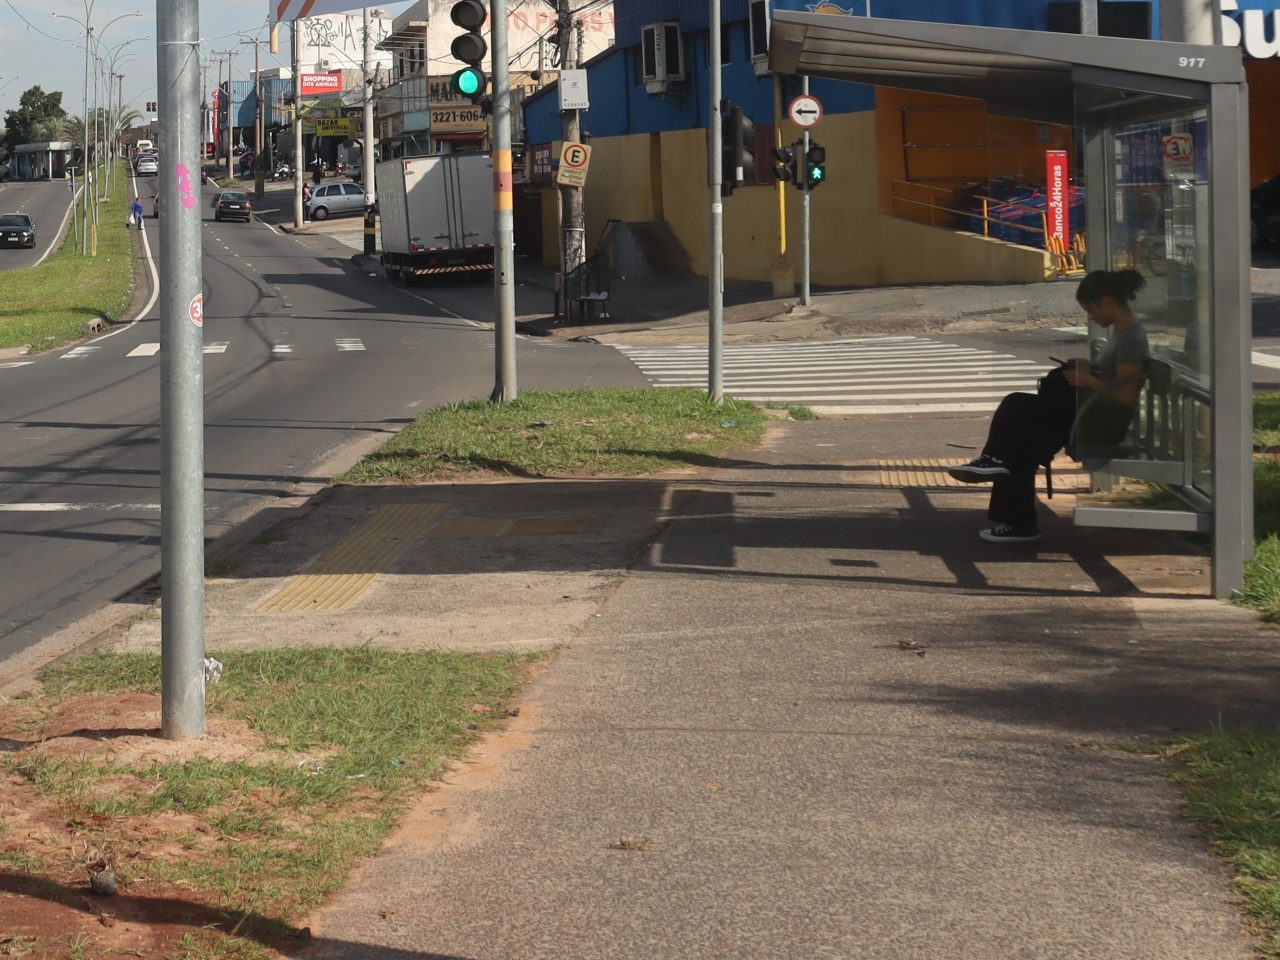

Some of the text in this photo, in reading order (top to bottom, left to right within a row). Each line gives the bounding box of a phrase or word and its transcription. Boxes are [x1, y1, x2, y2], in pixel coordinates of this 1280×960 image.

[1178, 56, 1206, 68] 917
[432, 110, 486, 123] 3221-6064
[571, 149, 581, 163] E
